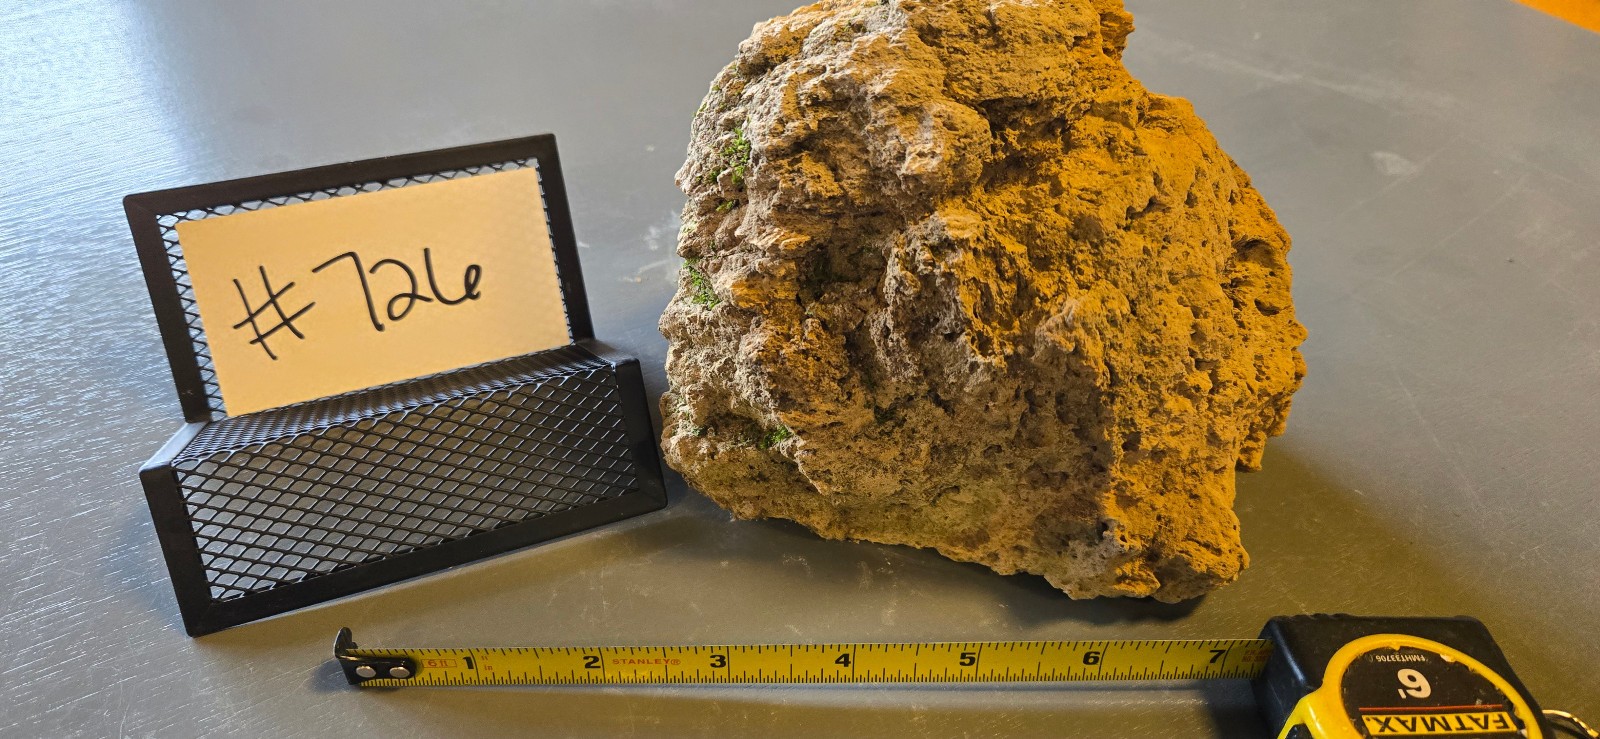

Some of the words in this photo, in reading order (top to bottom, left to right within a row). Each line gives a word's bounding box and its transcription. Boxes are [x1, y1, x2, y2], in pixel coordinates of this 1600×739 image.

[463, 656, 475, 669] 1
[583, 655, 601, 669] 2
[710, 654, 727, 668] 3
[835, 653, 852, 668] 4
[959, 652, 977, 667] 5
[1082, 651, 1100, 666] 6
[1210, 649, 1226, 663] 7
